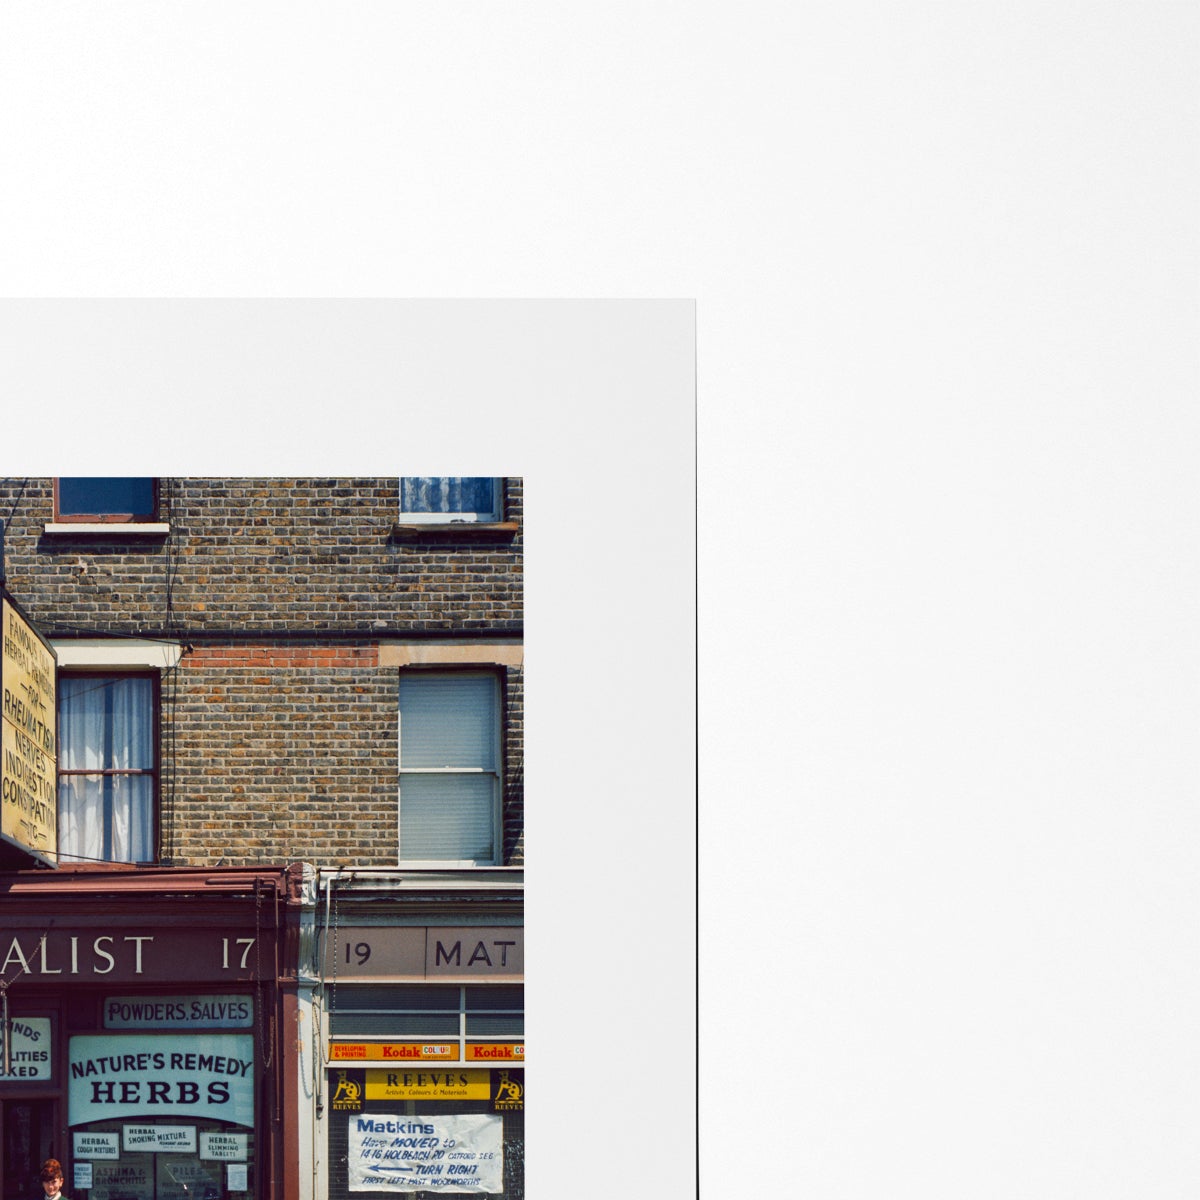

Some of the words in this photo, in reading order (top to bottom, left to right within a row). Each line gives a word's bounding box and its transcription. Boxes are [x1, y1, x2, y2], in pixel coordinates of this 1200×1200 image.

[4, 634, 31, 676] HERBAL
[28, 685, 39, 708] FOR
[14, 729, 46, 773] NERVES
[222, 938, 256, 970] 17
[345, 942, 372, 966] 19
[435, 940, 516, 967] MAT
[383, 1046, 421, 1058] Kodak
[474, 1046, 512, 1058] Kodak
[71, 1053, 165, 1079] NATURE'S
[170, 1054, 253, 1078] REMEDY
[387, 1073, 469, 1087] REEVES
[90, 1081, 230, 1104] HERBS
[440, 1089, 468, 1097] Materials
[357, 1119, 435, 1135] Matkins
[81, 1137, 110, 1145] HERBAL
[128, 1135, 156, 1145] SMOKING
[157, 1132, 187, 1142] MIXTURE
[208, 1136, 238, 1145] HERBAL
[390, 1138, 440, 1149] MOVED
[443, 1139, 456, 1148] to
[383, 1151, 430, 1160] HOLBEACH
[416, 1165, 443, 1175] TURN
[447, 1165, 478, 1175] RIGHT
